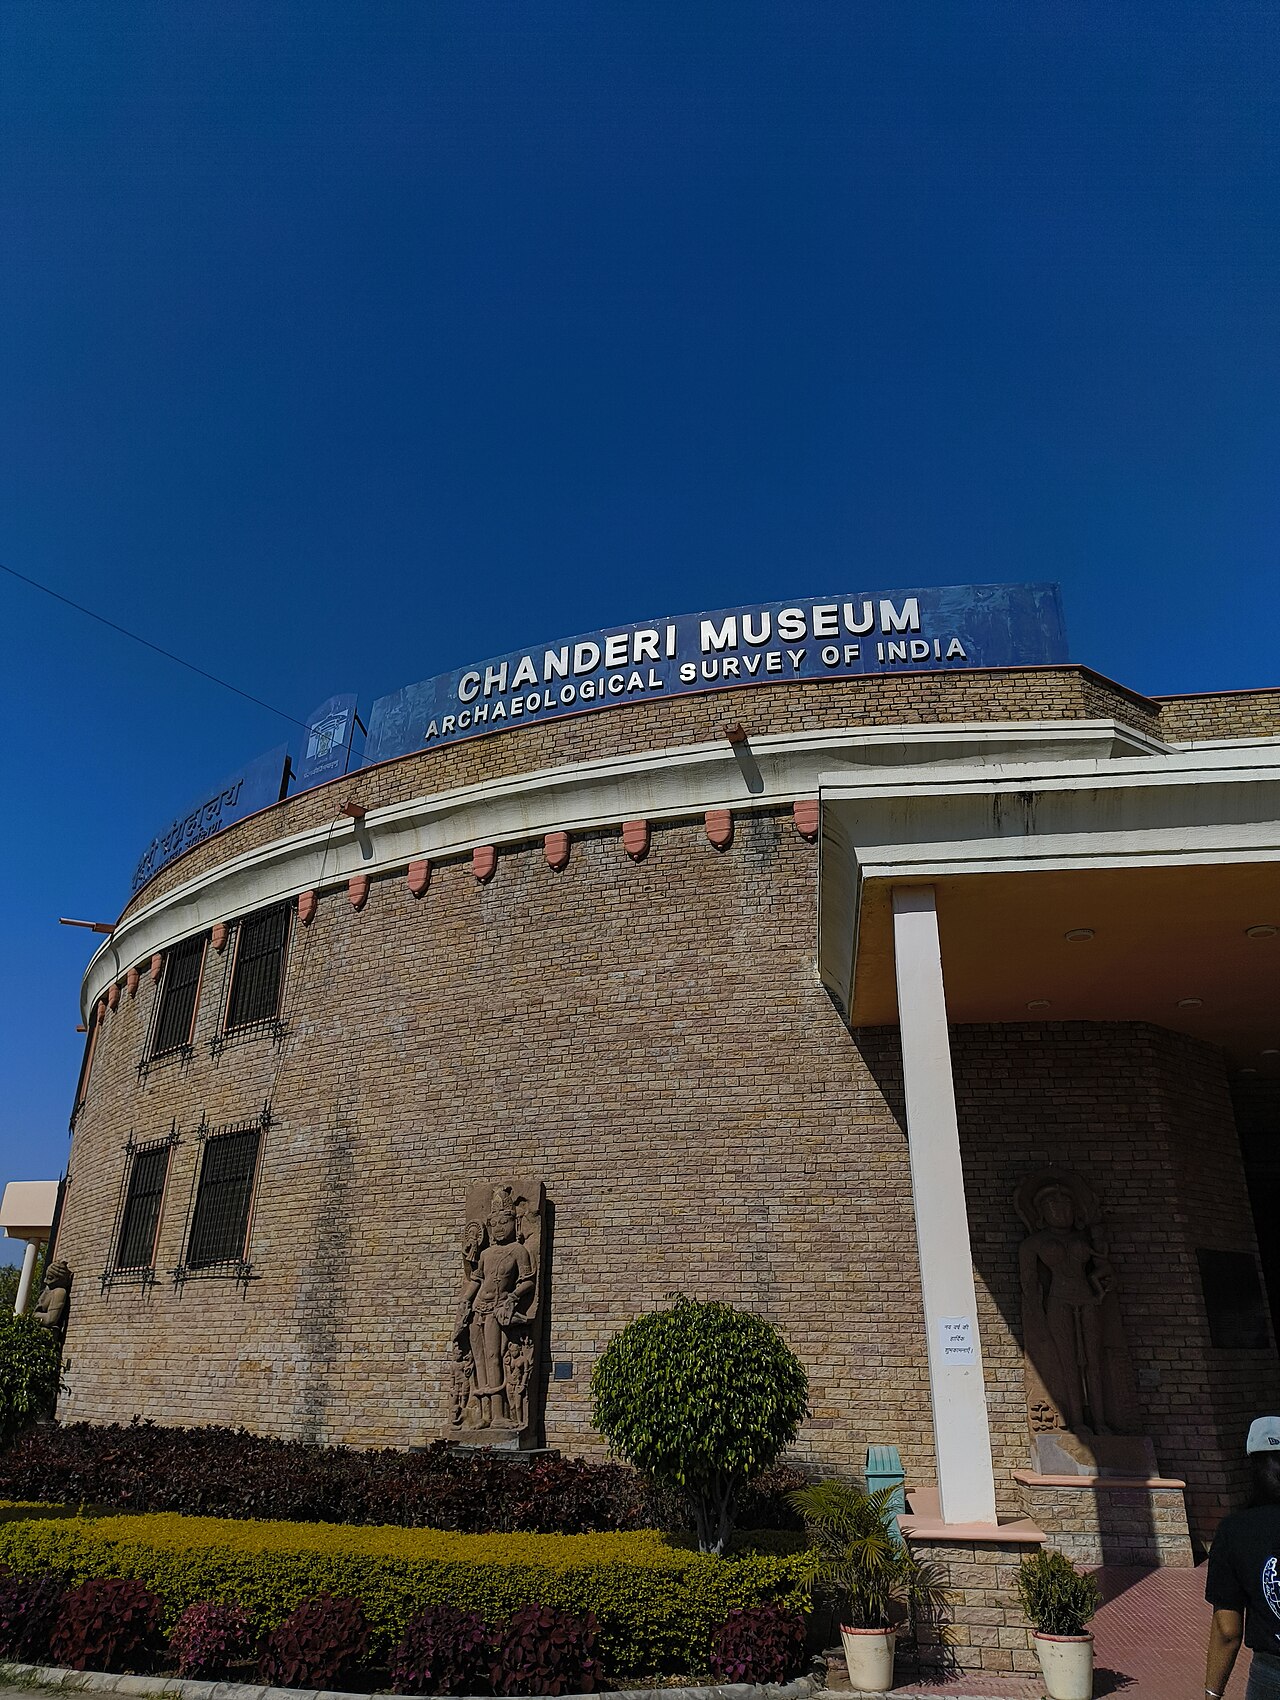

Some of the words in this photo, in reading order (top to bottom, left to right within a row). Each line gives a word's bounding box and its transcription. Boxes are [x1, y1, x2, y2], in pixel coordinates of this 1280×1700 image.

[425, 668, 664, 740] ARCHAEOLOGICAL
[679, 649, 806, 682] SURVEY
[821, 644, 860, 666] OF
[876, 637, 967, 664] INDIA
[458, 624, 677, 703] CHANDERI
[700, 597, 922, 655] MUSEUM
[949, 1334, 965, 1342] हार्दिक
